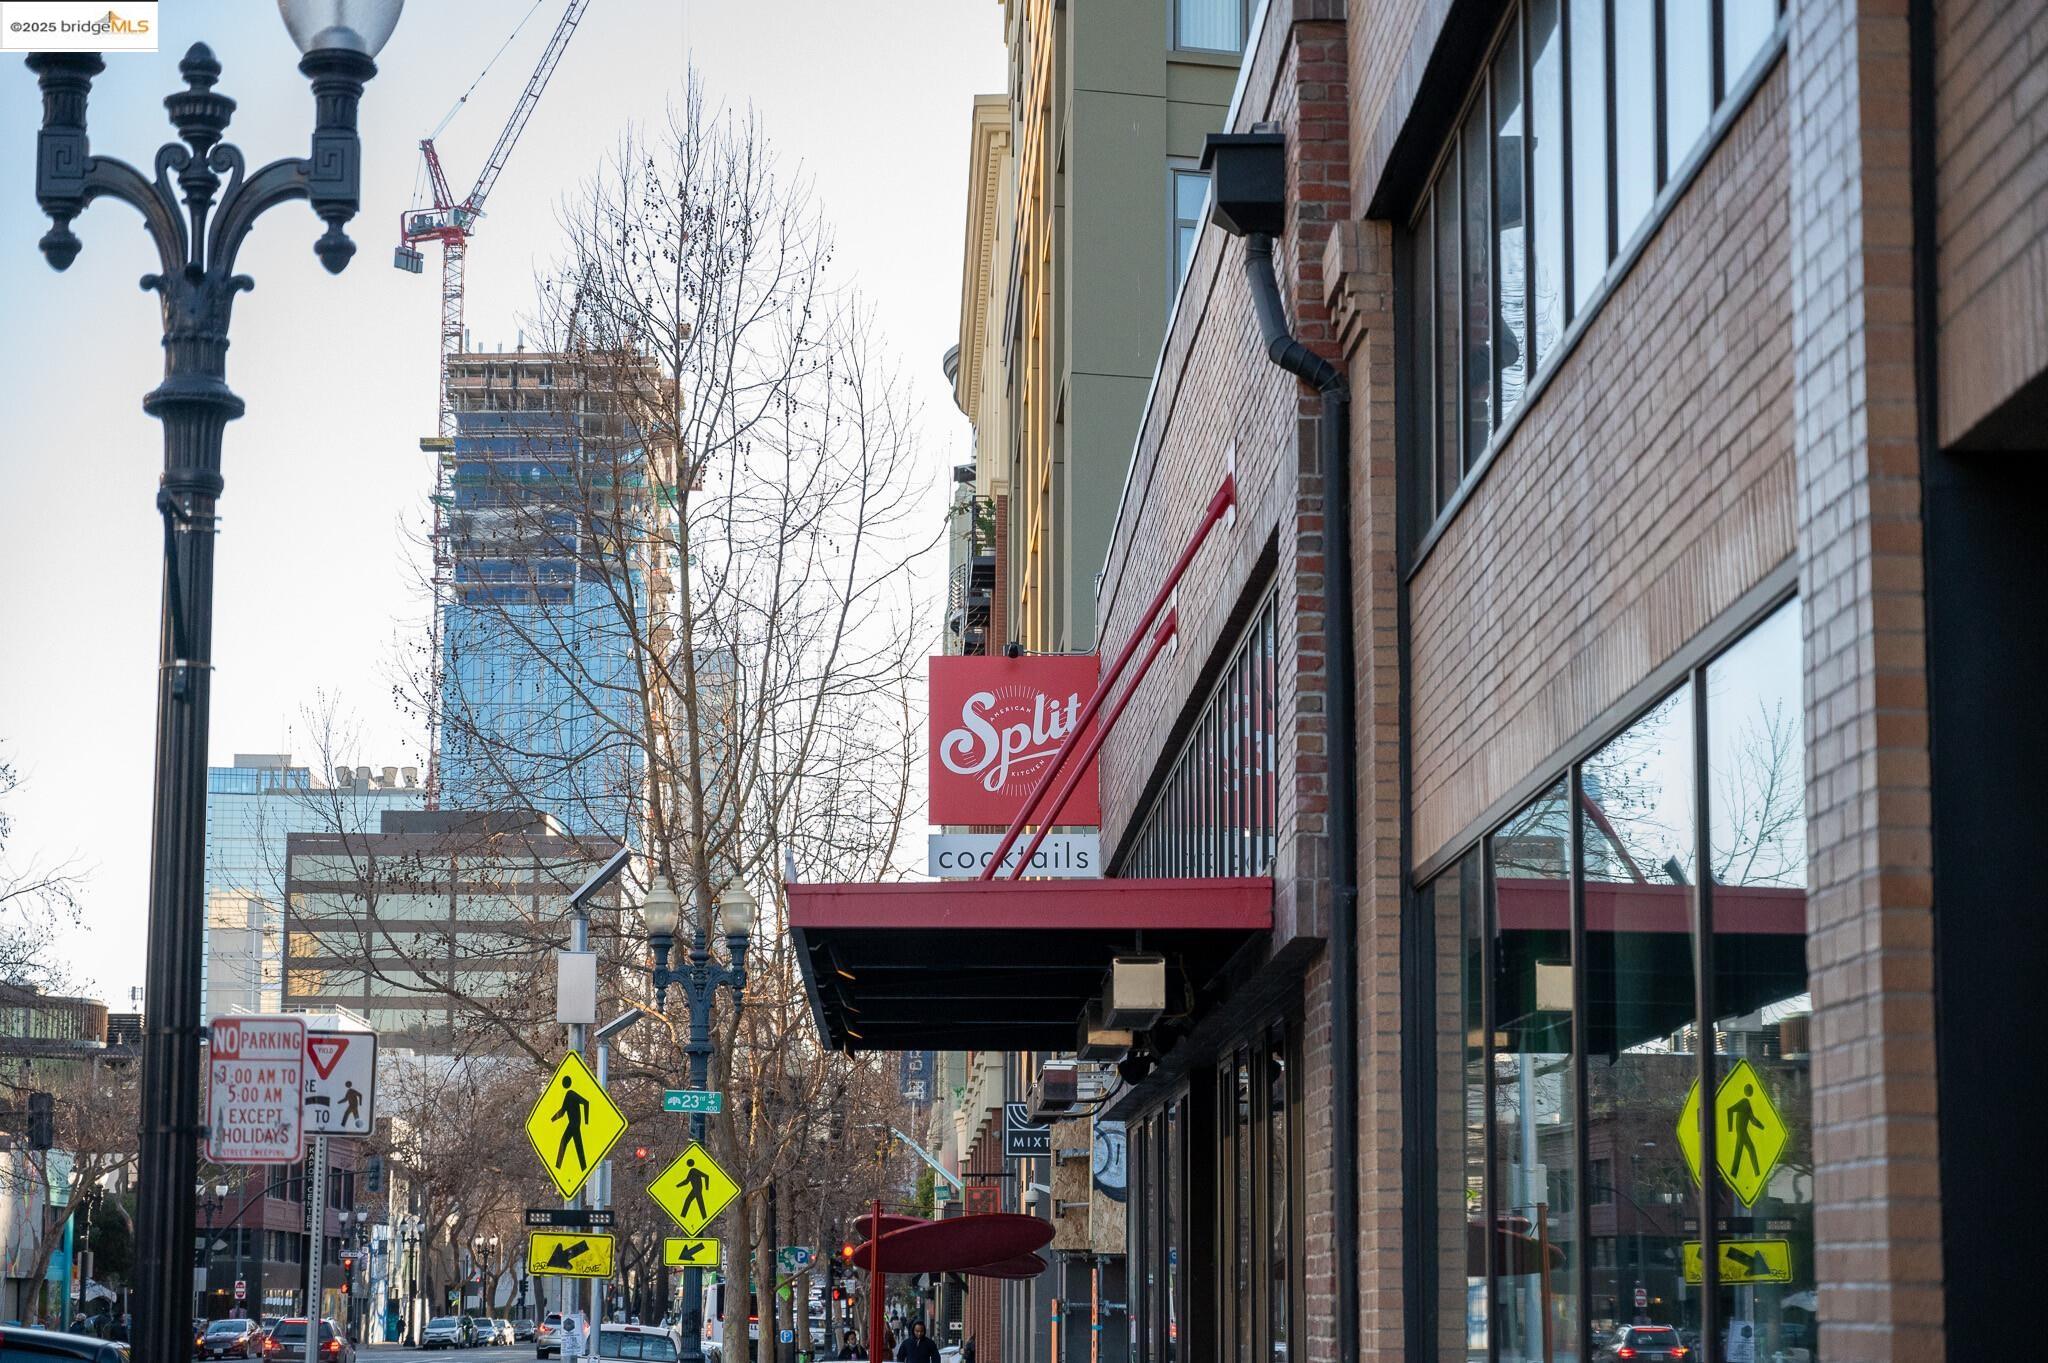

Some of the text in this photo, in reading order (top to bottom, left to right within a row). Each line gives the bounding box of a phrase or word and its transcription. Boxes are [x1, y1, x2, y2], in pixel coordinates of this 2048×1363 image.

[990, 705, 1032, 722] AMERICAN
[940, 691, 1082, 792] Split
[1011, 760, 1045, 777] KITCHEN
[212, 1027, 300, 1054] NO PARKING
[258, 1069, 275, 1084] AM
[282, 1069, 296, 1084] TO
[228, 1084, 282, 1103] 5:00 AM
[682, 1094, 705, 1108] 23rd
[229, 1108, 283, 1124] EXCEPT
[315, 1110, 330, 1123] TO
[222, 1127, 289, 1144] HOLIDAYS
[1013, 1136, 1050, 1147] MIXT
